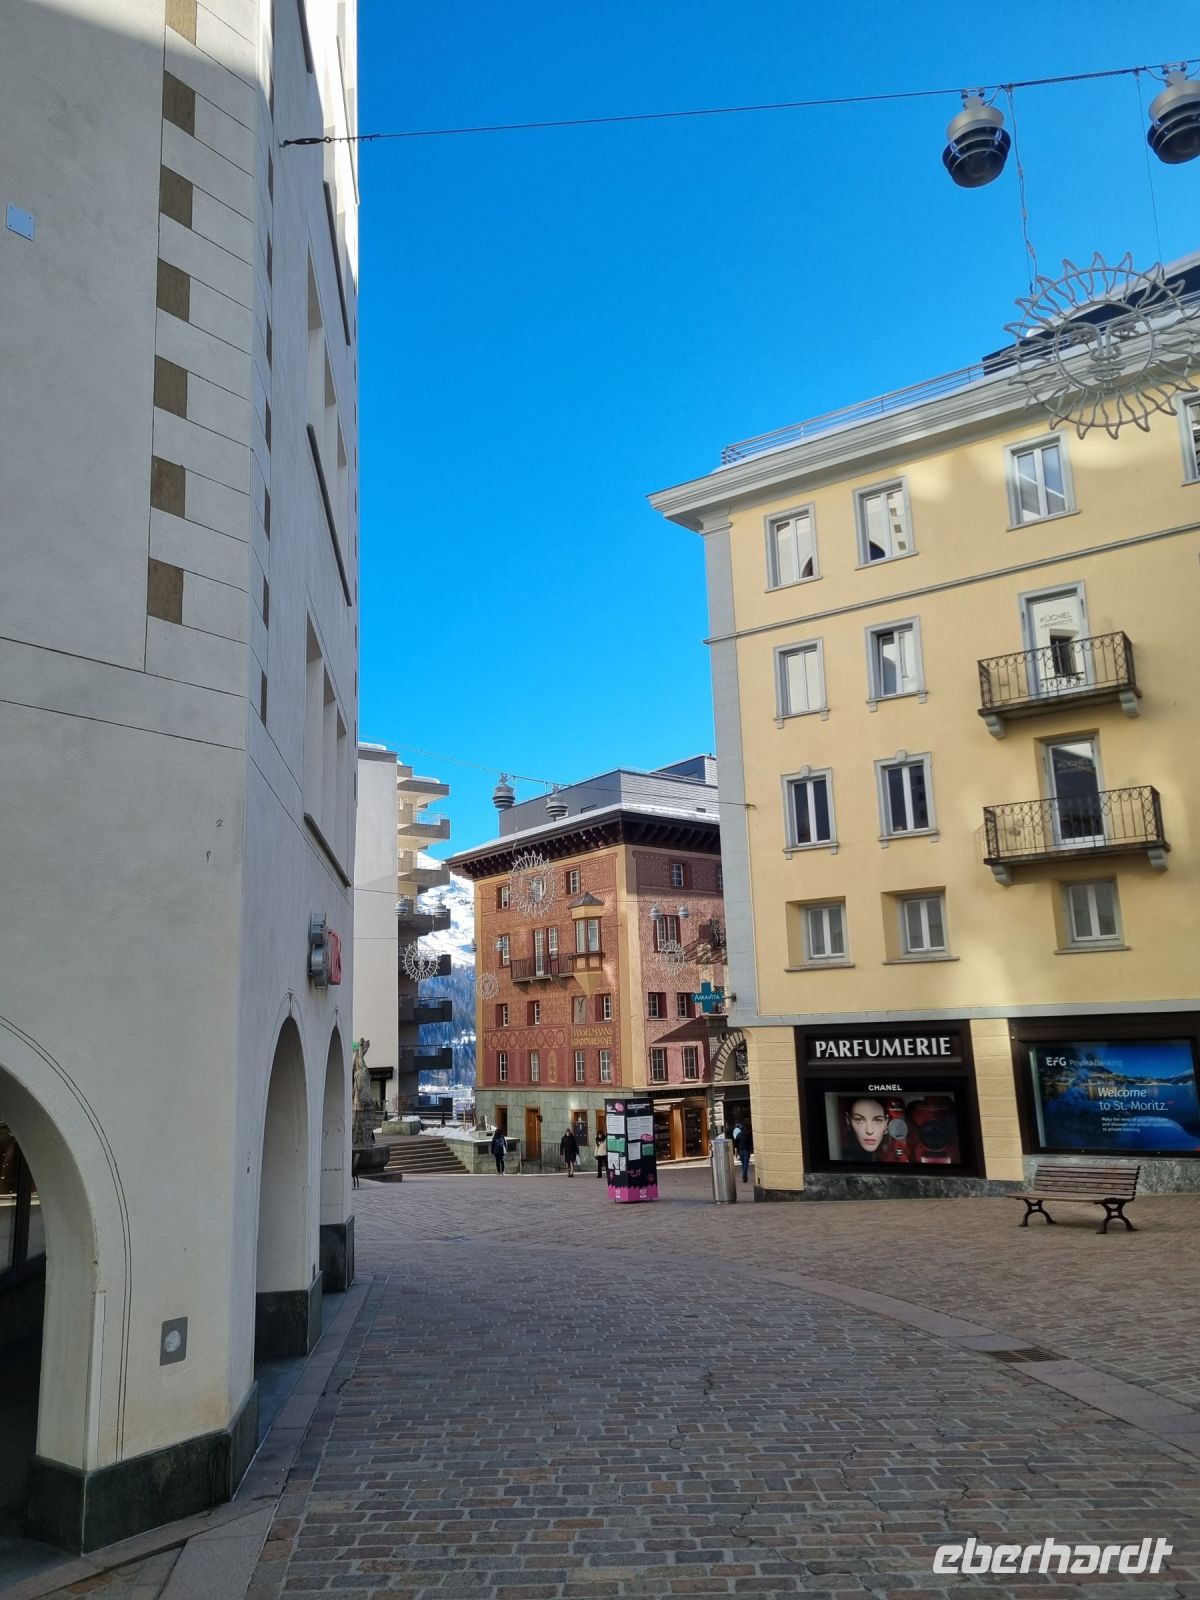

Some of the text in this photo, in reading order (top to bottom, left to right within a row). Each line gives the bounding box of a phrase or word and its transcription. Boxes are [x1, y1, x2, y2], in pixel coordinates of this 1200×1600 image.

[815, 1037, 951, 1058] PARFUMERIE
[1046, 1056, 1067, 1066] EFG
[1098, 1087, 1147, 1098] Welcome
[1099, 1102, 1111, 1111] to
[1131, 1101, 1169, 1111] Moritz.
